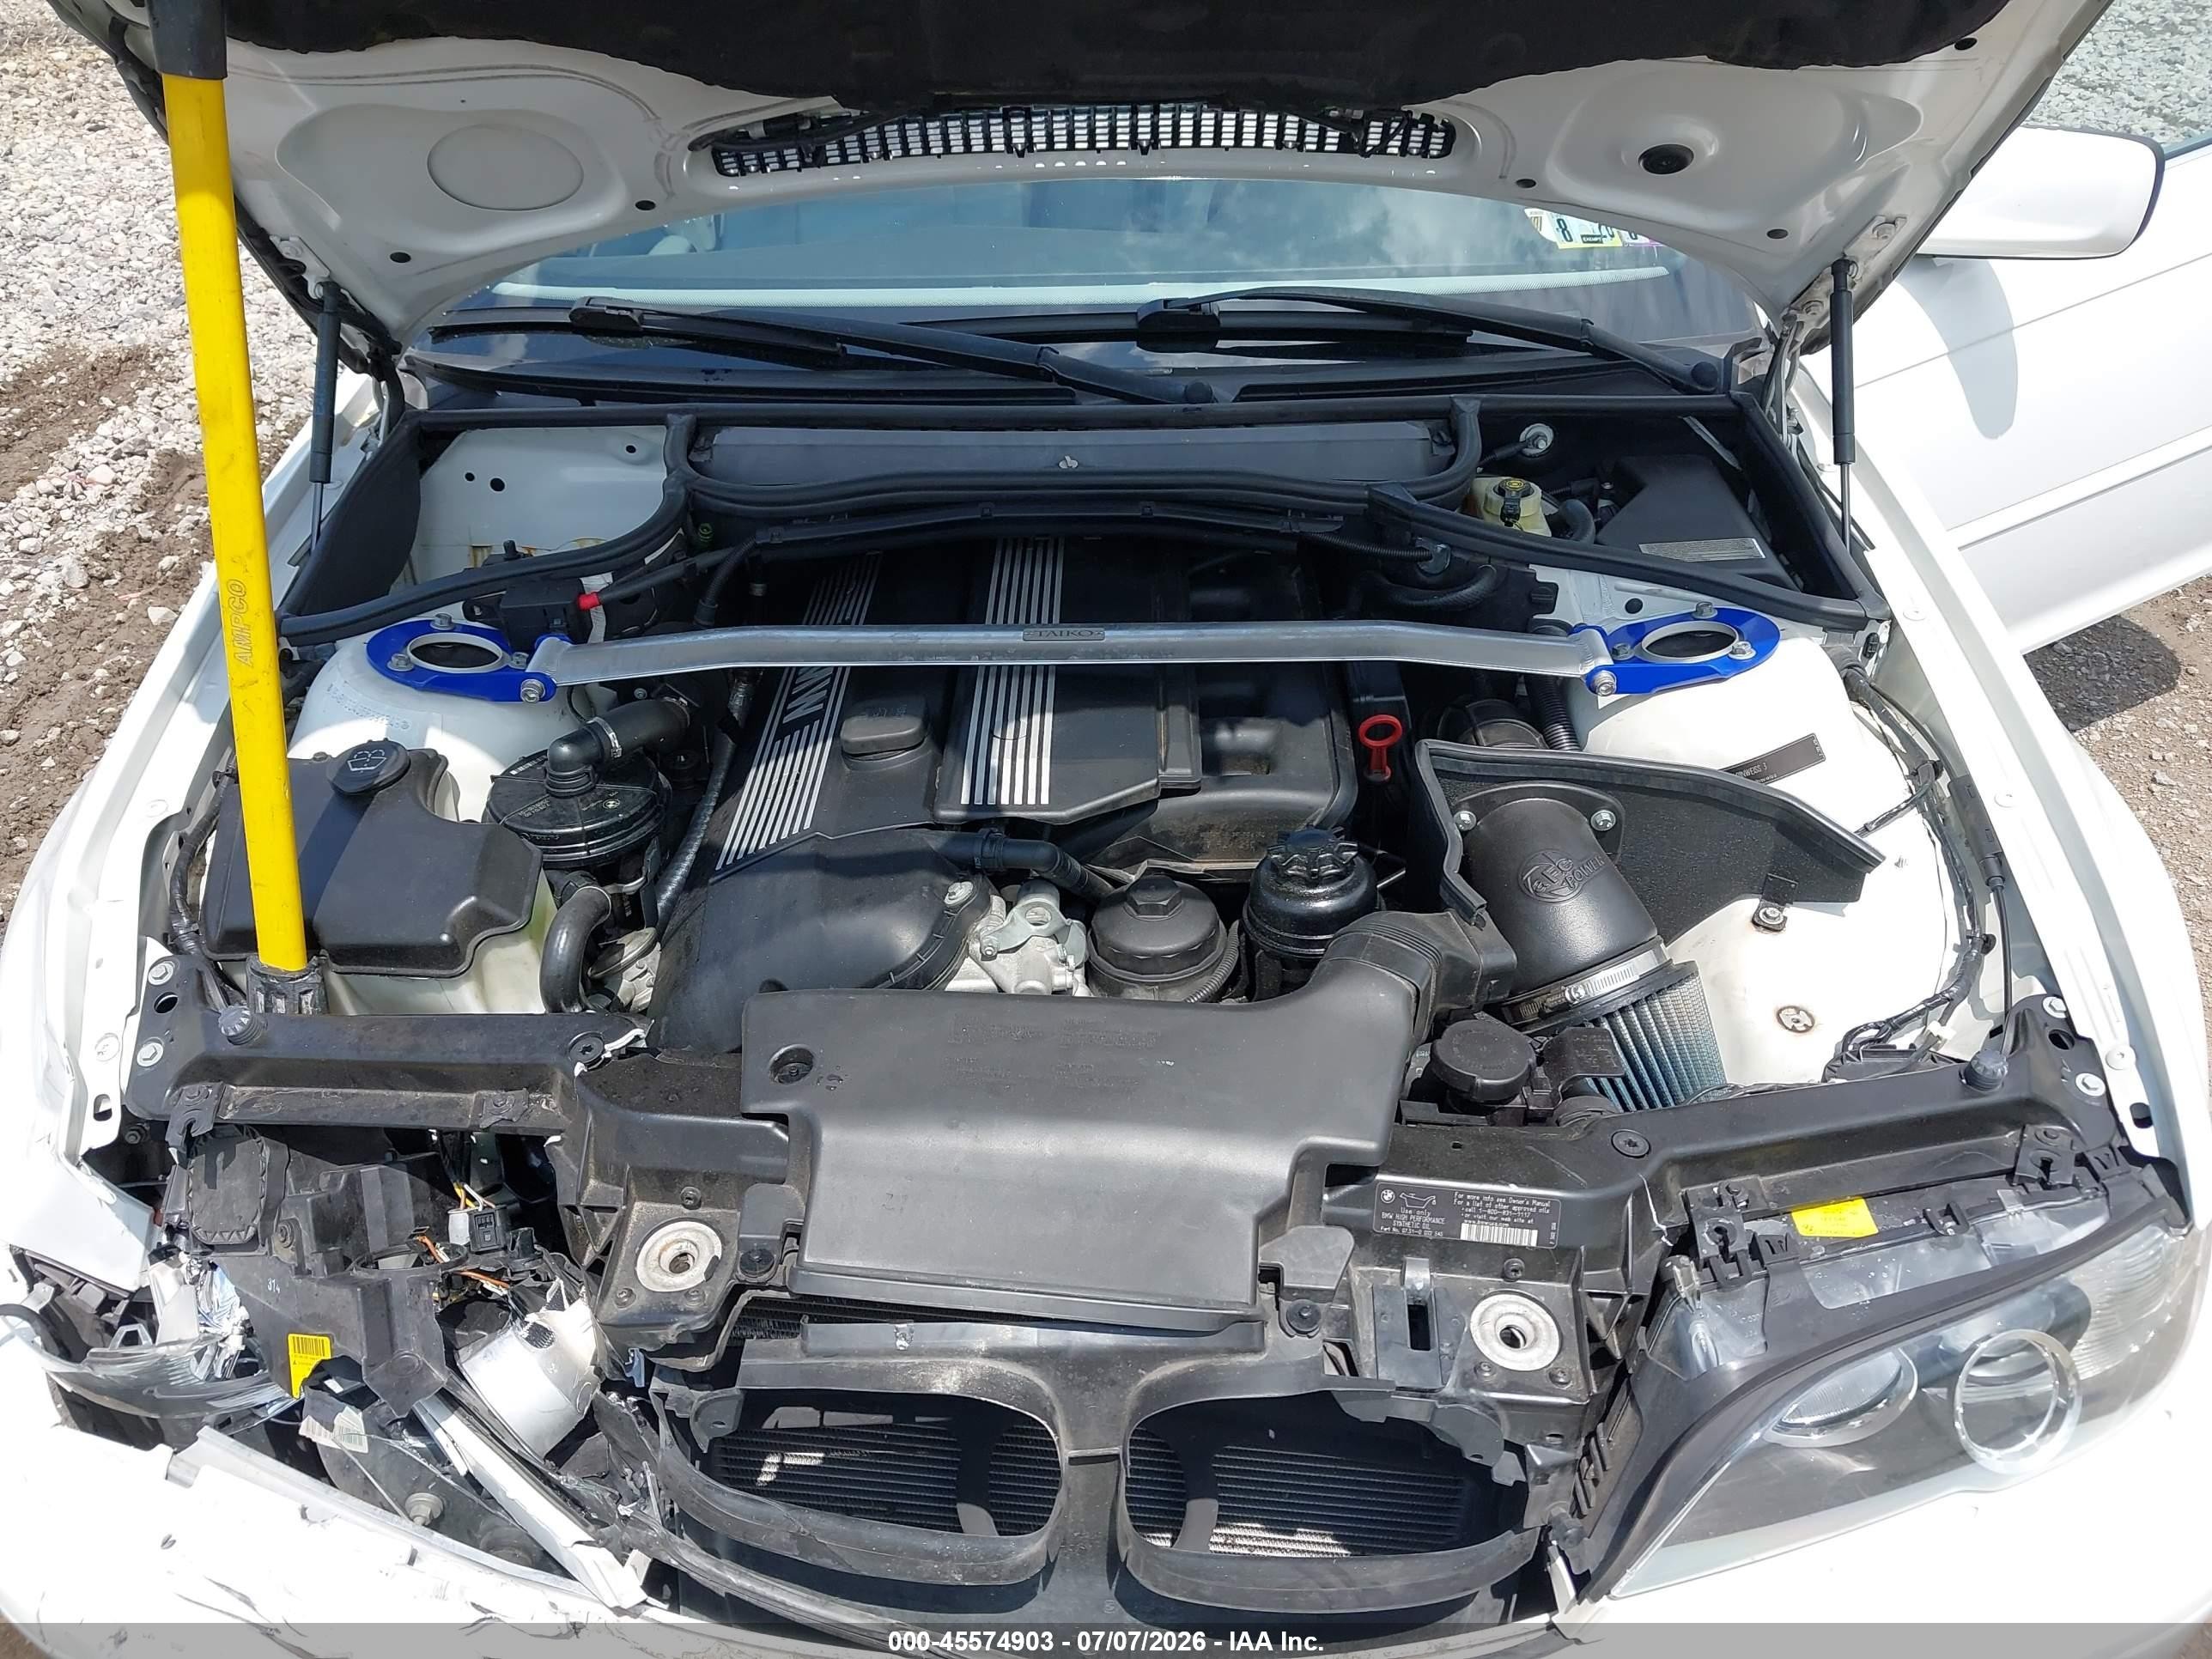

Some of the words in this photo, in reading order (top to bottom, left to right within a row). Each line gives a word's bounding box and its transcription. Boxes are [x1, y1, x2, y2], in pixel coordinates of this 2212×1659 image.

[227, 578, 253, 667] AMPCO
[1565, 855, 1606, 890] POWER
[1532, 1199, 1552, 1207] Manual
[1395, 1212, 1408, 1221] HIGH
[1410, 1215, 1446, 1224] PERFORMANCE
[1416, 1209, 1431, 1218] only
[1393, 1220, 1420, 1229] SYNTHETIC
